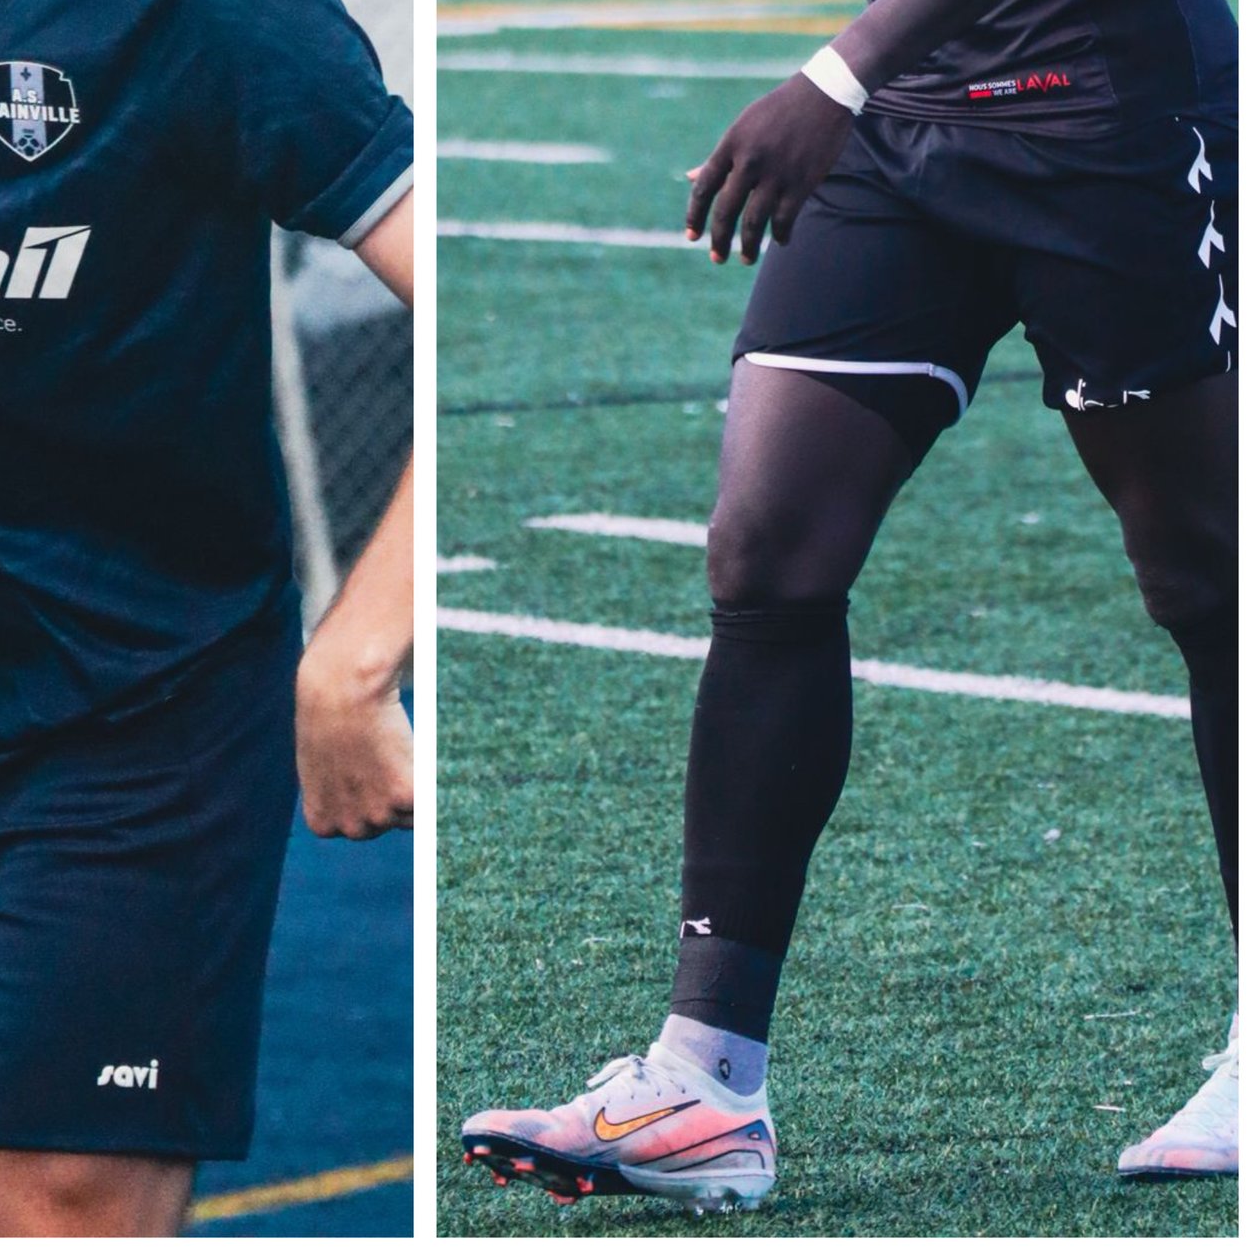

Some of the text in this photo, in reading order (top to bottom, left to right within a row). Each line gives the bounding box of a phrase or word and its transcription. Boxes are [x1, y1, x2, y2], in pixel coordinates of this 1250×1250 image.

[1017, 72, 1070, 92] LAVAL
[12, 88, 42, 104] A.S.
[96, 1058, 159, 1089] savi
